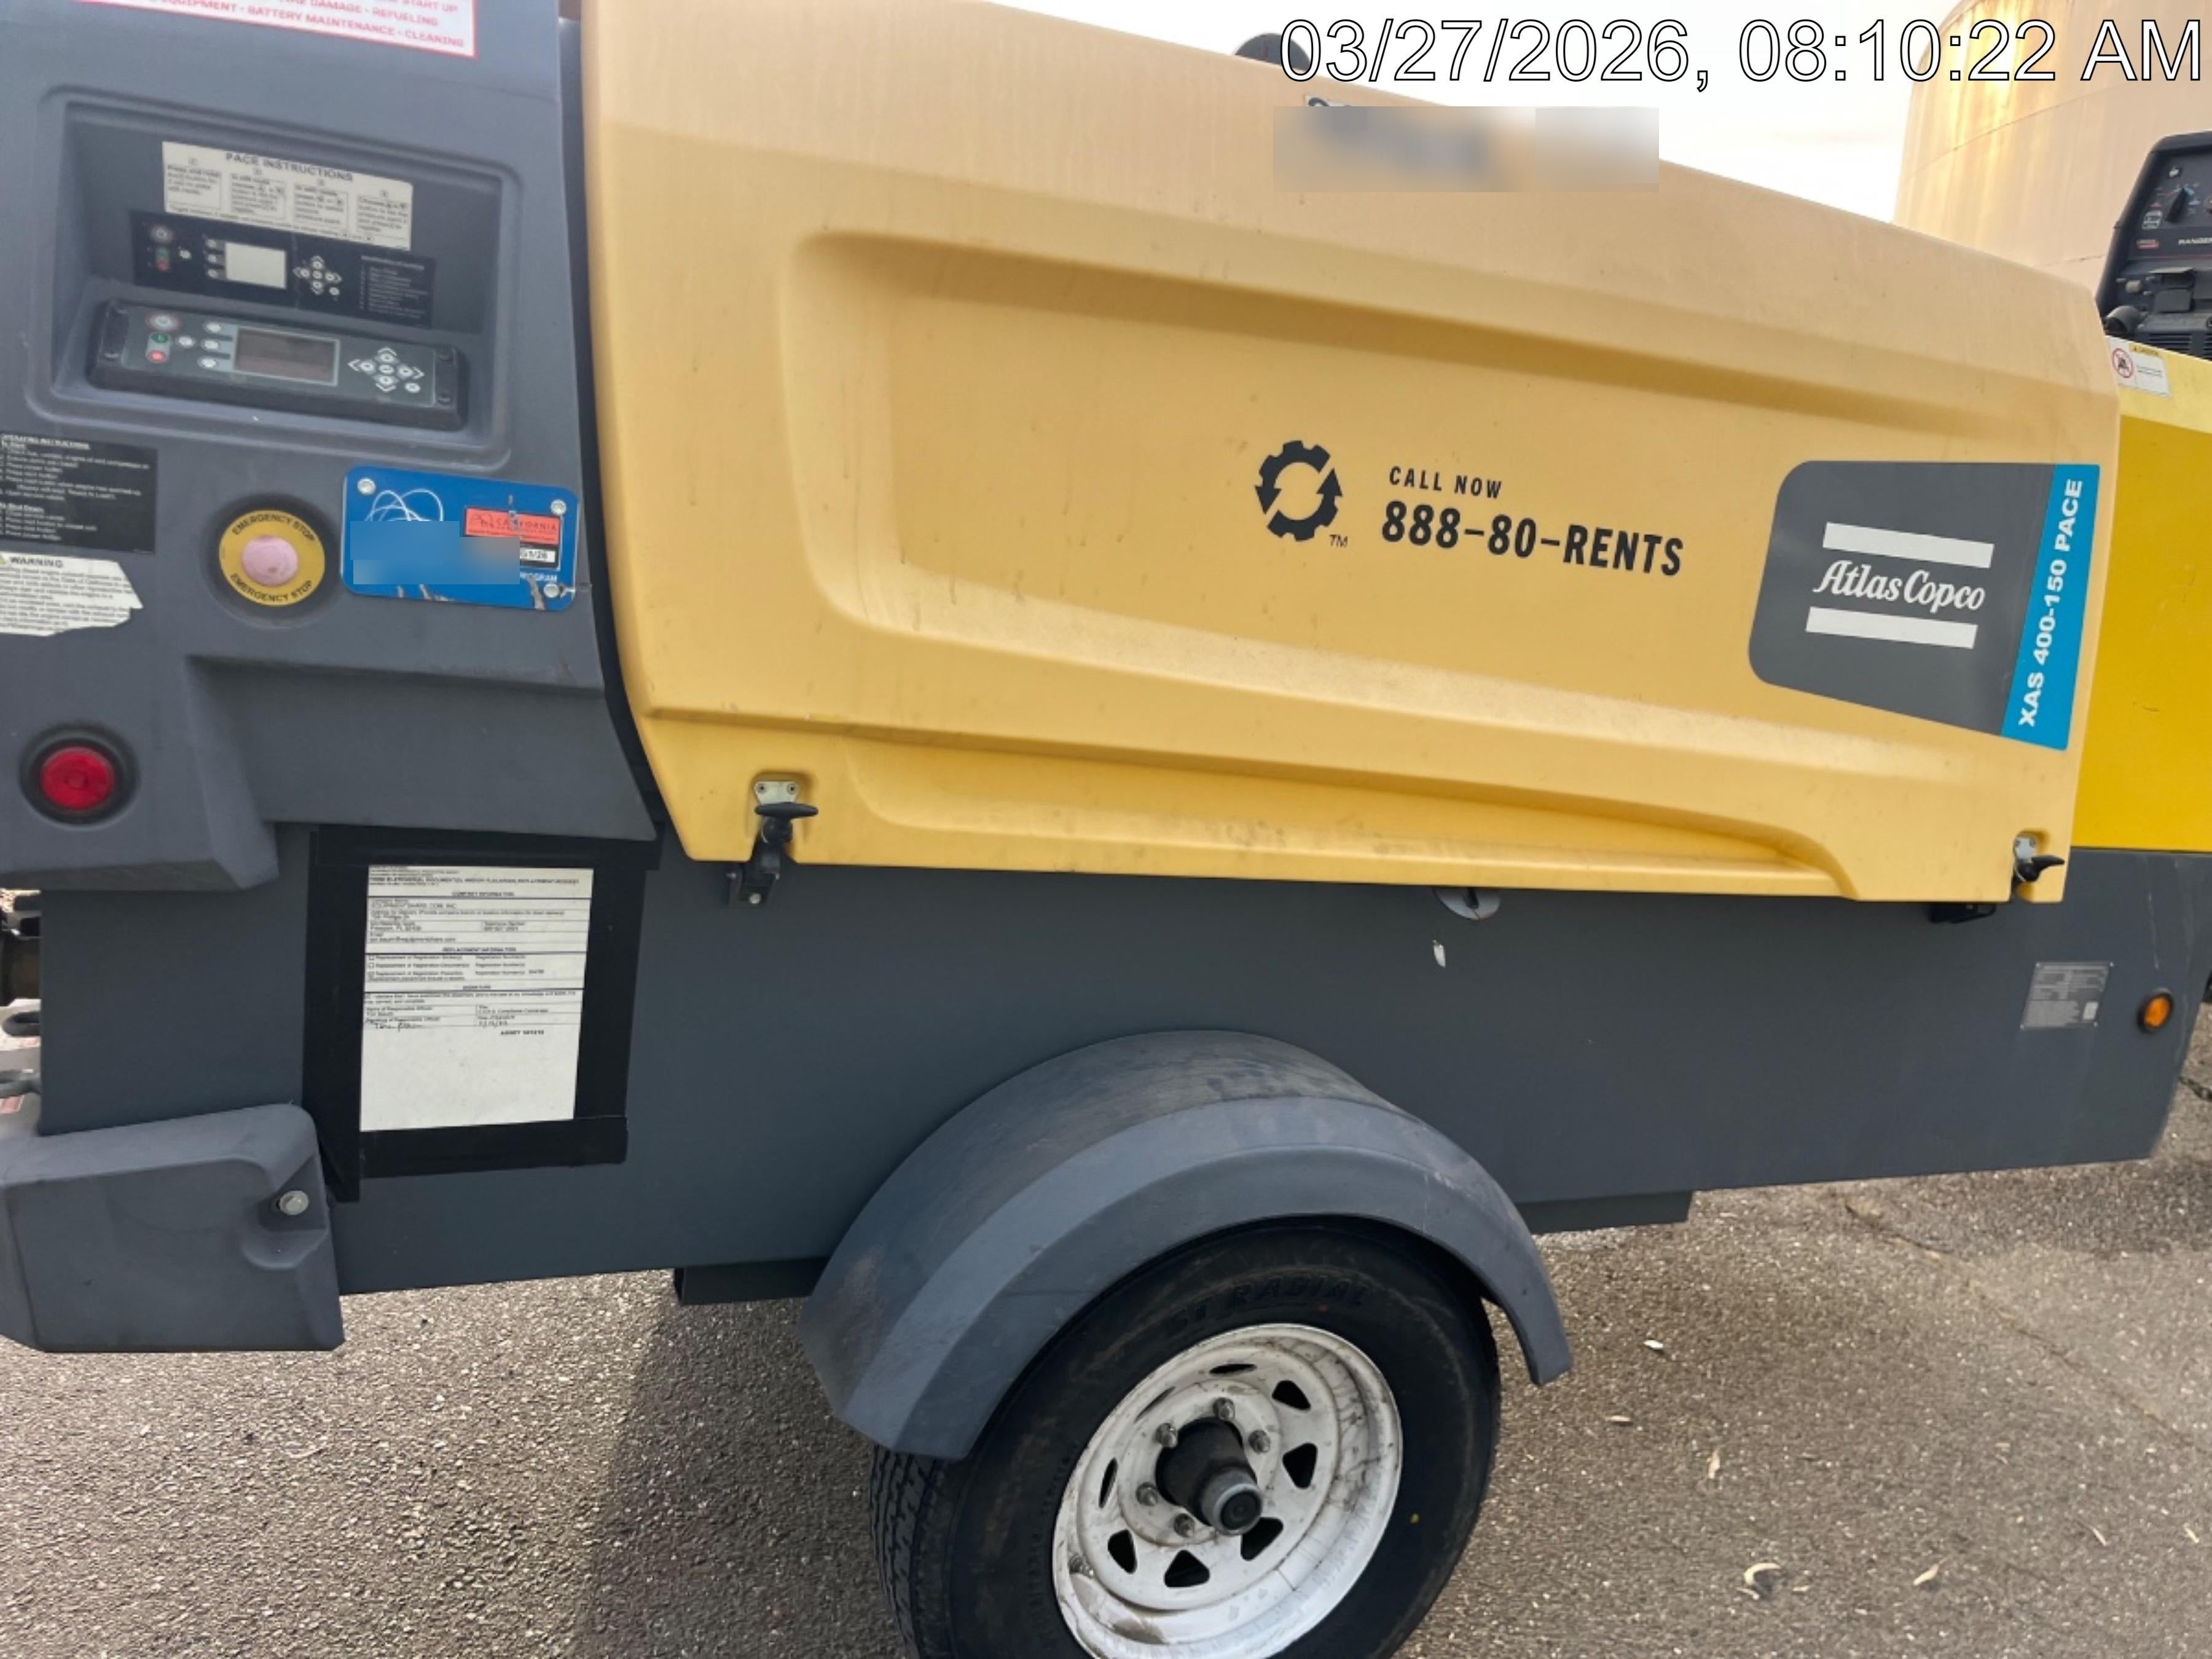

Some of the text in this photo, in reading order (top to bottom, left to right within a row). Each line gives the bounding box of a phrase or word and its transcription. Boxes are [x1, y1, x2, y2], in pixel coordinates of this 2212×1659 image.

[247, 6, 303, 21] BATTERY
[305, 14, 395, 35] MAINTENANCE
[404, 29, 464, 47] CLEANING
[372, 7, 438, 26] REFUELING
[263, 158, 353, 182] INSTRUCTIONS
[1389, 466, 1502, 499] CALL NOW
[231, 514, 316, 541] EMERGENCY STOP
[1328, 533, 1348, 549] TM
[1381, 500, 1684, 576] 888-80-RENTS
[10, 556, 63, 568] WARNING
[230, 573, 312, 603] EMERGENCY STOP
[1812, 559, 1986, 613] Atlas Copco
[2018, 479, 2083, 728] XAS 400-150 PACE
